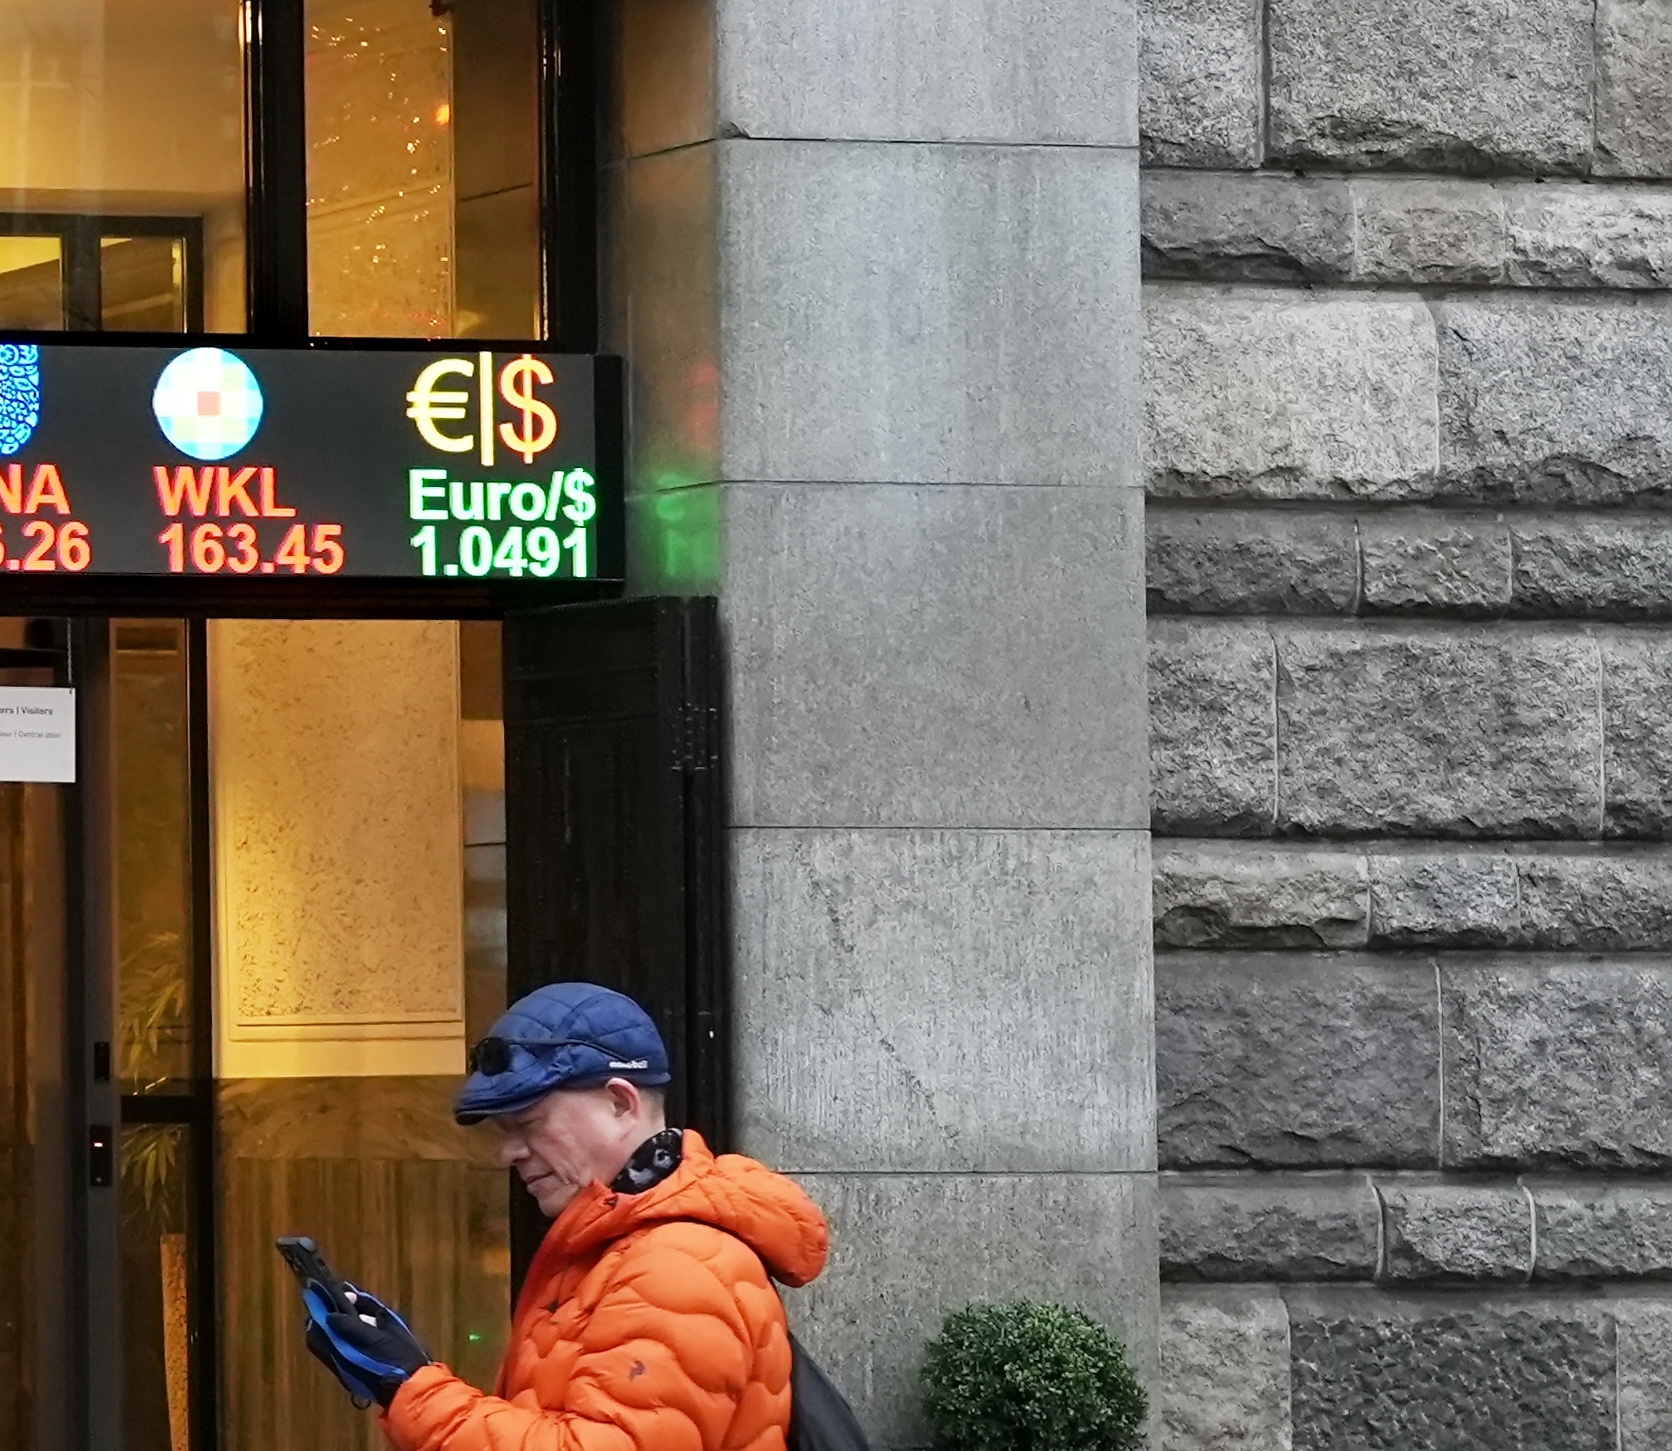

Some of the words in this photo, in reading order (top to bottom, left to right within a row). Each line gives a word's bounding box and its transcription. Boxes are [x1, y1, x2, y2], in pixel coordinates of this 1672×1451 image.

[153, 466, 296, 519] WKL
[409, 467, 597, 529] Euro/$
[158, 522, 345, 575] 163.45
[411, 524, 588, 577] 1.0491
[21, 706, 54, 715] Visitors
